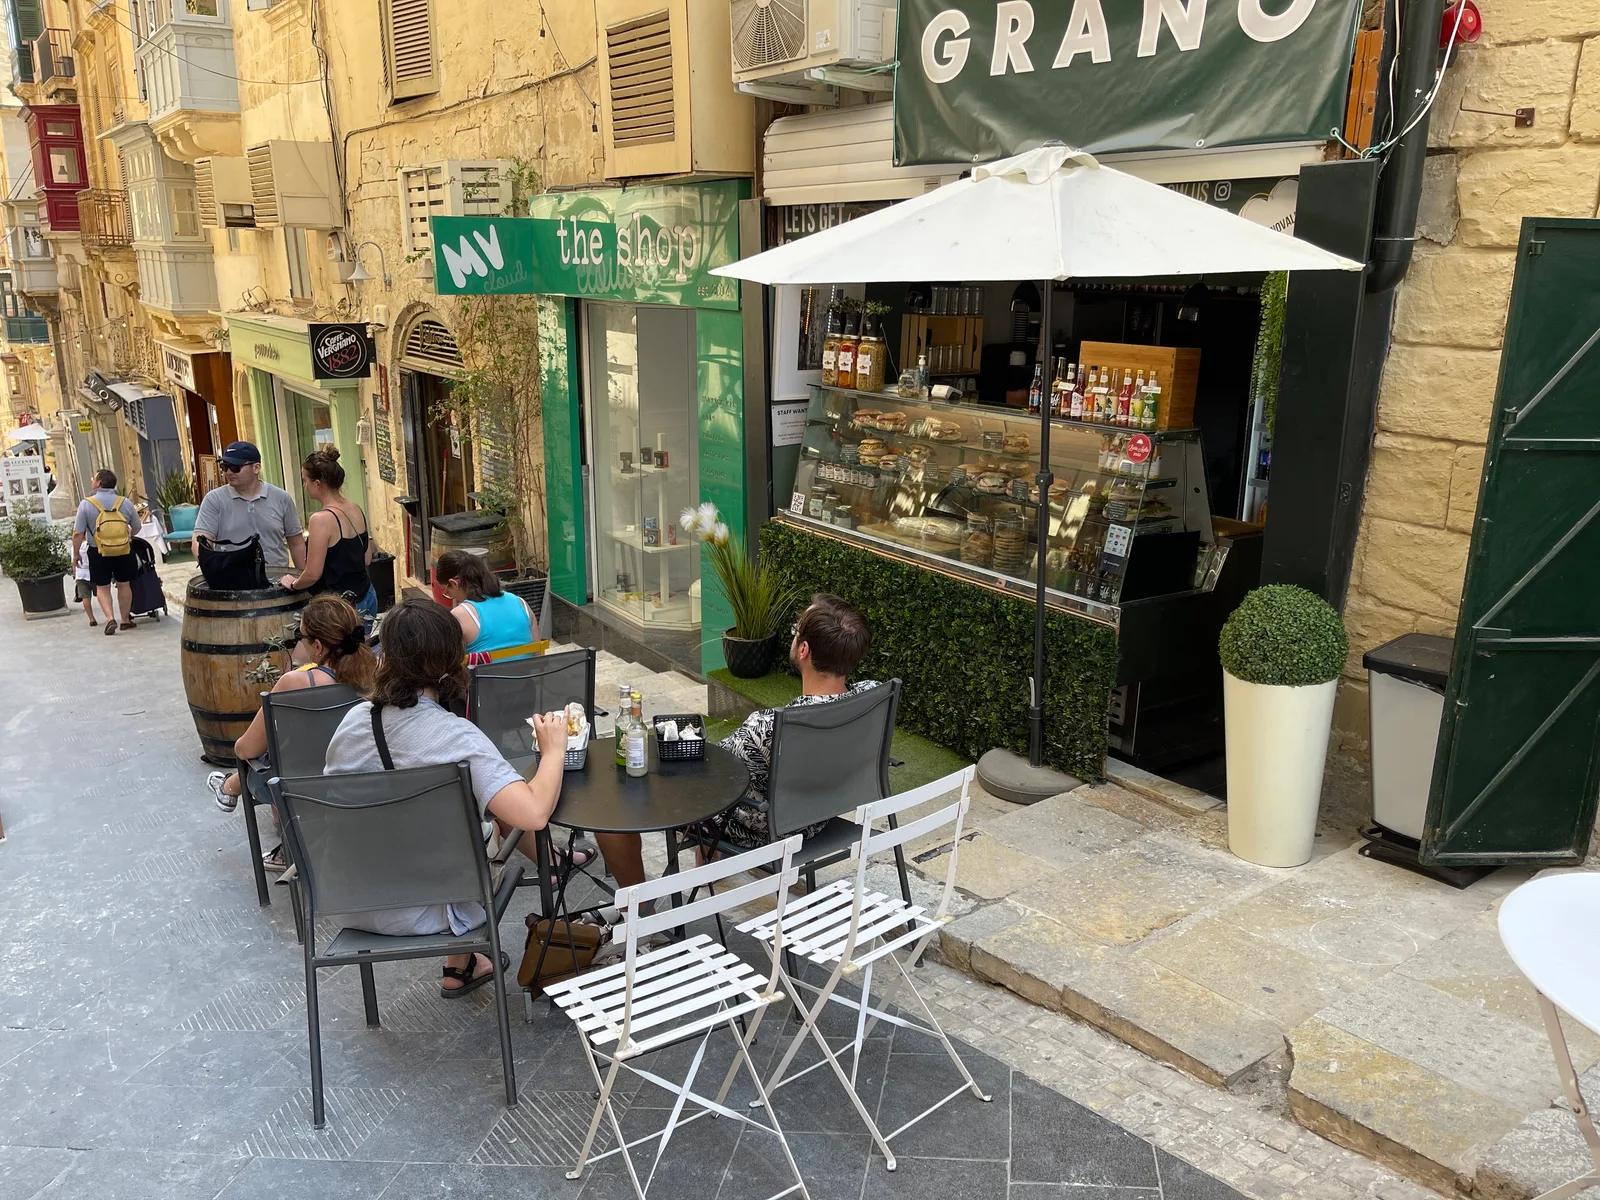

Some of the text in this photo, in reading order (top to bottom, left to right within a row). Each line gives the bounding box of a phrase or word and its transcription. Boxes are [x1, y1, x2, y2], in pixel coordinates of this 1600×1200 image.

[920, 0, 1317, 84] GRANO
[785, 202, 846, 233] LETS GET
[441, 224, 504, 289] MV
[556, 211, 698, 282] the shop
[483, 260, 527, 294] cloud
[317, 334, 357, 359] VERGNANO
[328, 344, 358, 372] 1882
